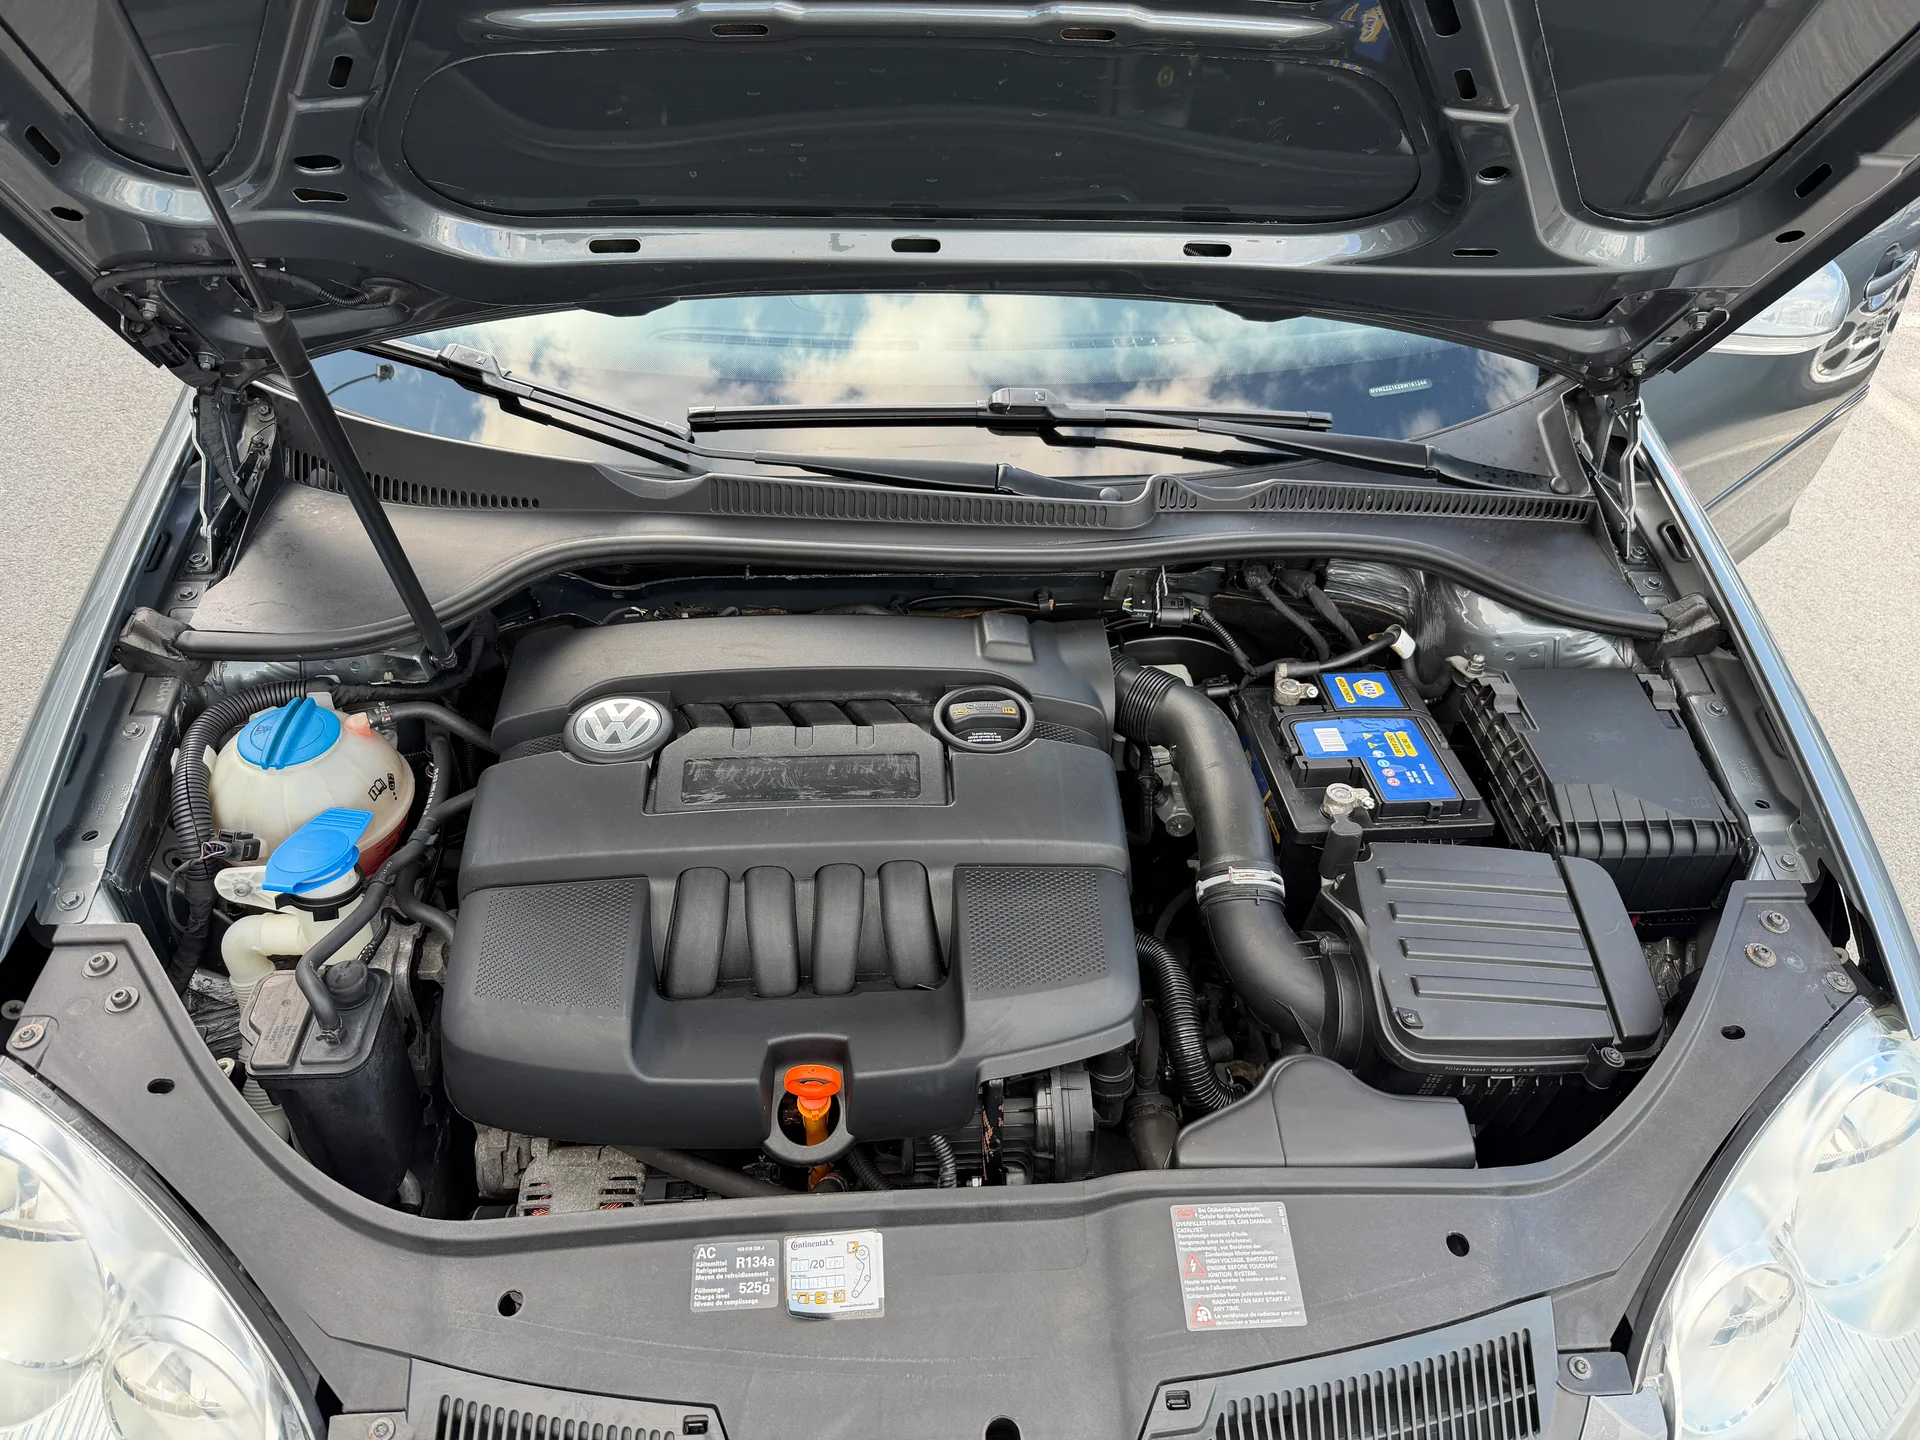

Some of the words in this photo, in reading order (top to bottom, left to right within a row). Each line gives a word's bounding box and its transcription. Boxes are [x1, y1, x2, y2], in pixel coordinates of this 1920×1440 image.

[575, 698, 660, 752] VW
[791, 1239, 828, 1250] Continental
[696, 1247, 716, 1259] AC
[736, 1256, 775, 1268] R134a
[810, 1259, 824, 1269] /20
